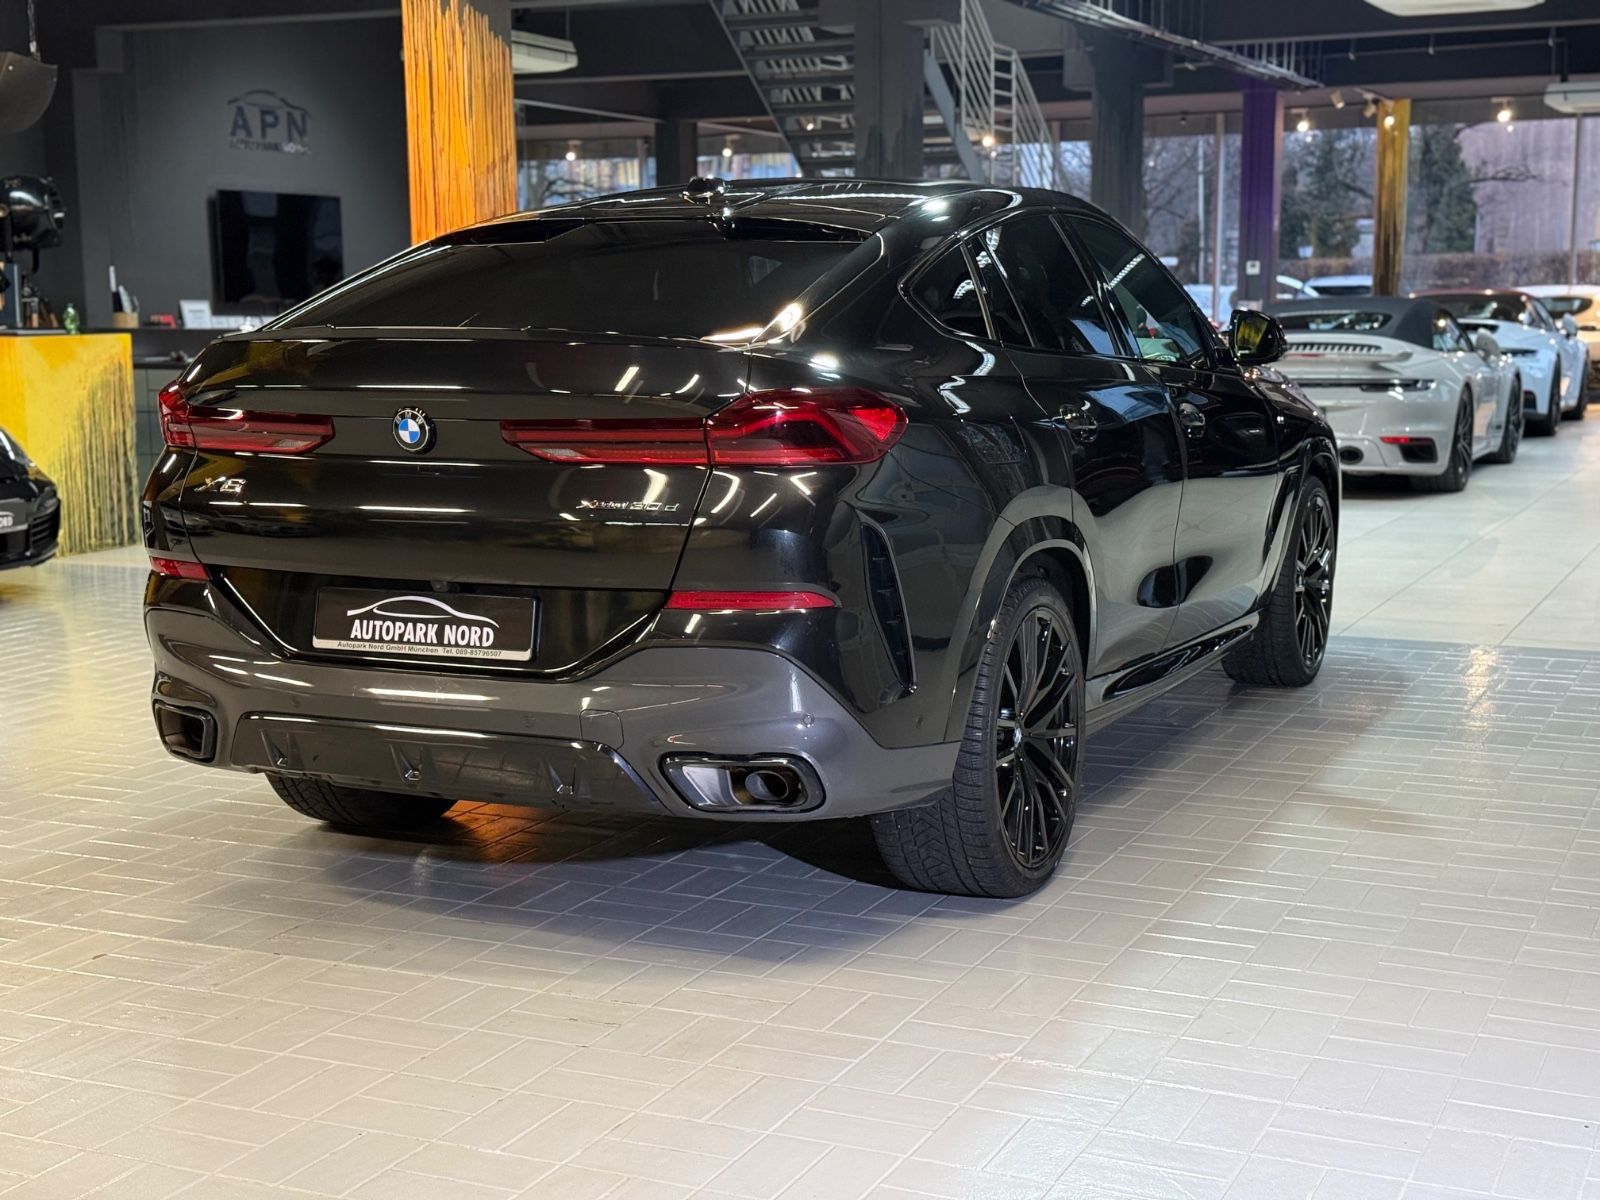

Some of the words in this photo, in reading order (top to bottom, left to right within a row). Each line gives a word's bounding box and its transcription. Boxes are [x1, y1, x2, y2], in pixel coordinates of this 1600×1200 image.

[230, 105, 307, 142] APN
[194, 476, 246, 493] X6
[350, 619, 438, 644] AUTOPARK
[443, 624, 494, 647] NORD
[337, 641, 367, 649] Autopark
[407, 645, 439, 653] München
[443, 647, 454, 655] Tel.
